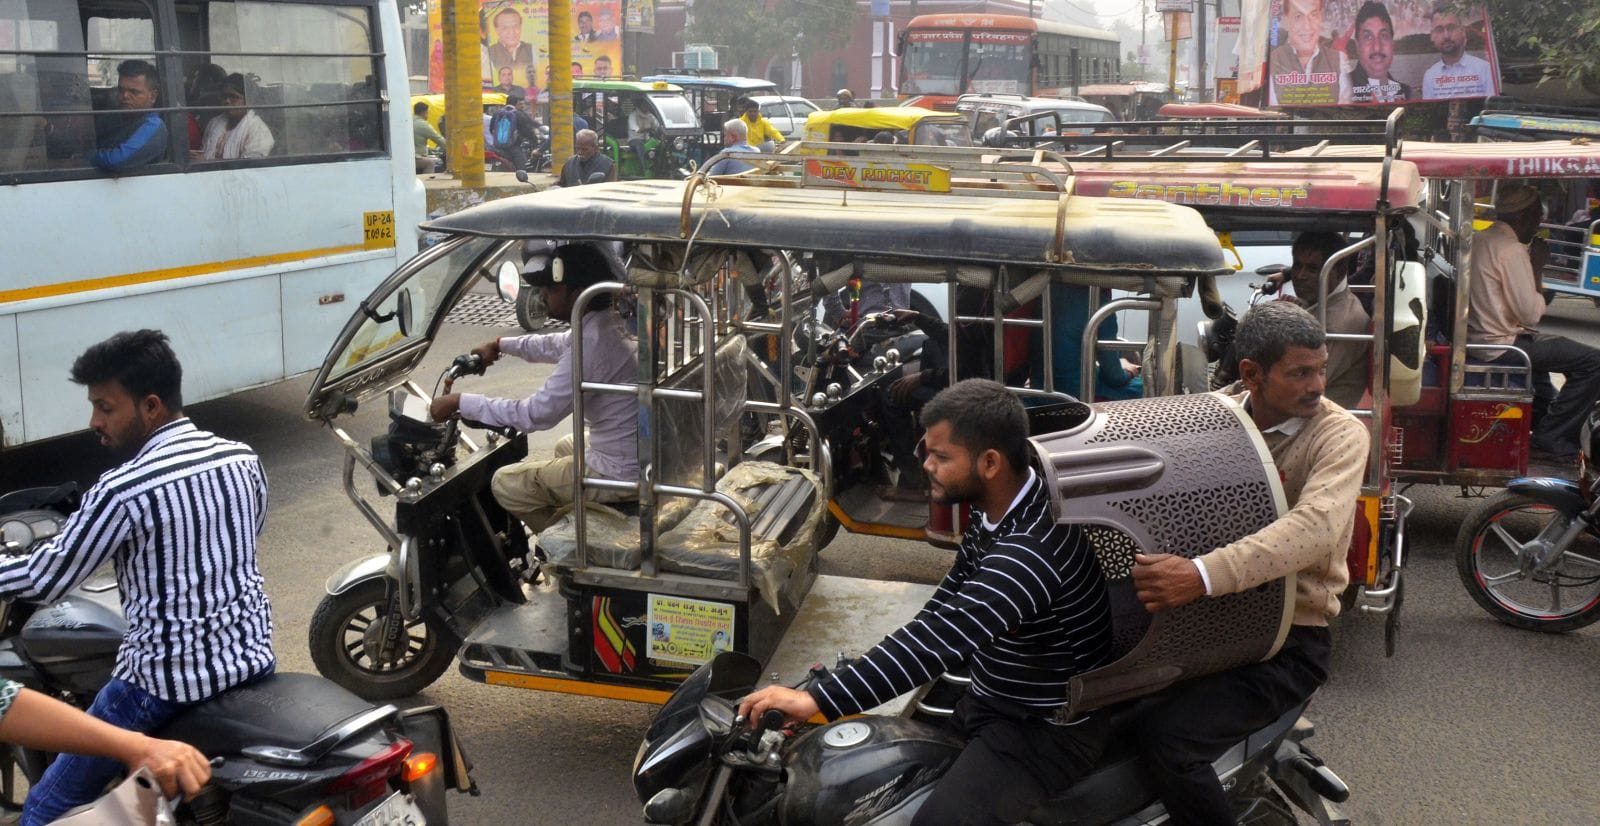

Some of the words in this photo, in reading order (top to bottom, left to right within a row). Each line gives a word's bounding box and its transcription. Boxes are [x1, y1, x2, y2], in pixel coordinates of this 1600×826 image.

[1310, 72, 1337, 84] पाठक
[821, 165, 857, 180] DEV
[861, 167, 933, 184] ROCKET
[1109, 180, 1308, 207] Panther
